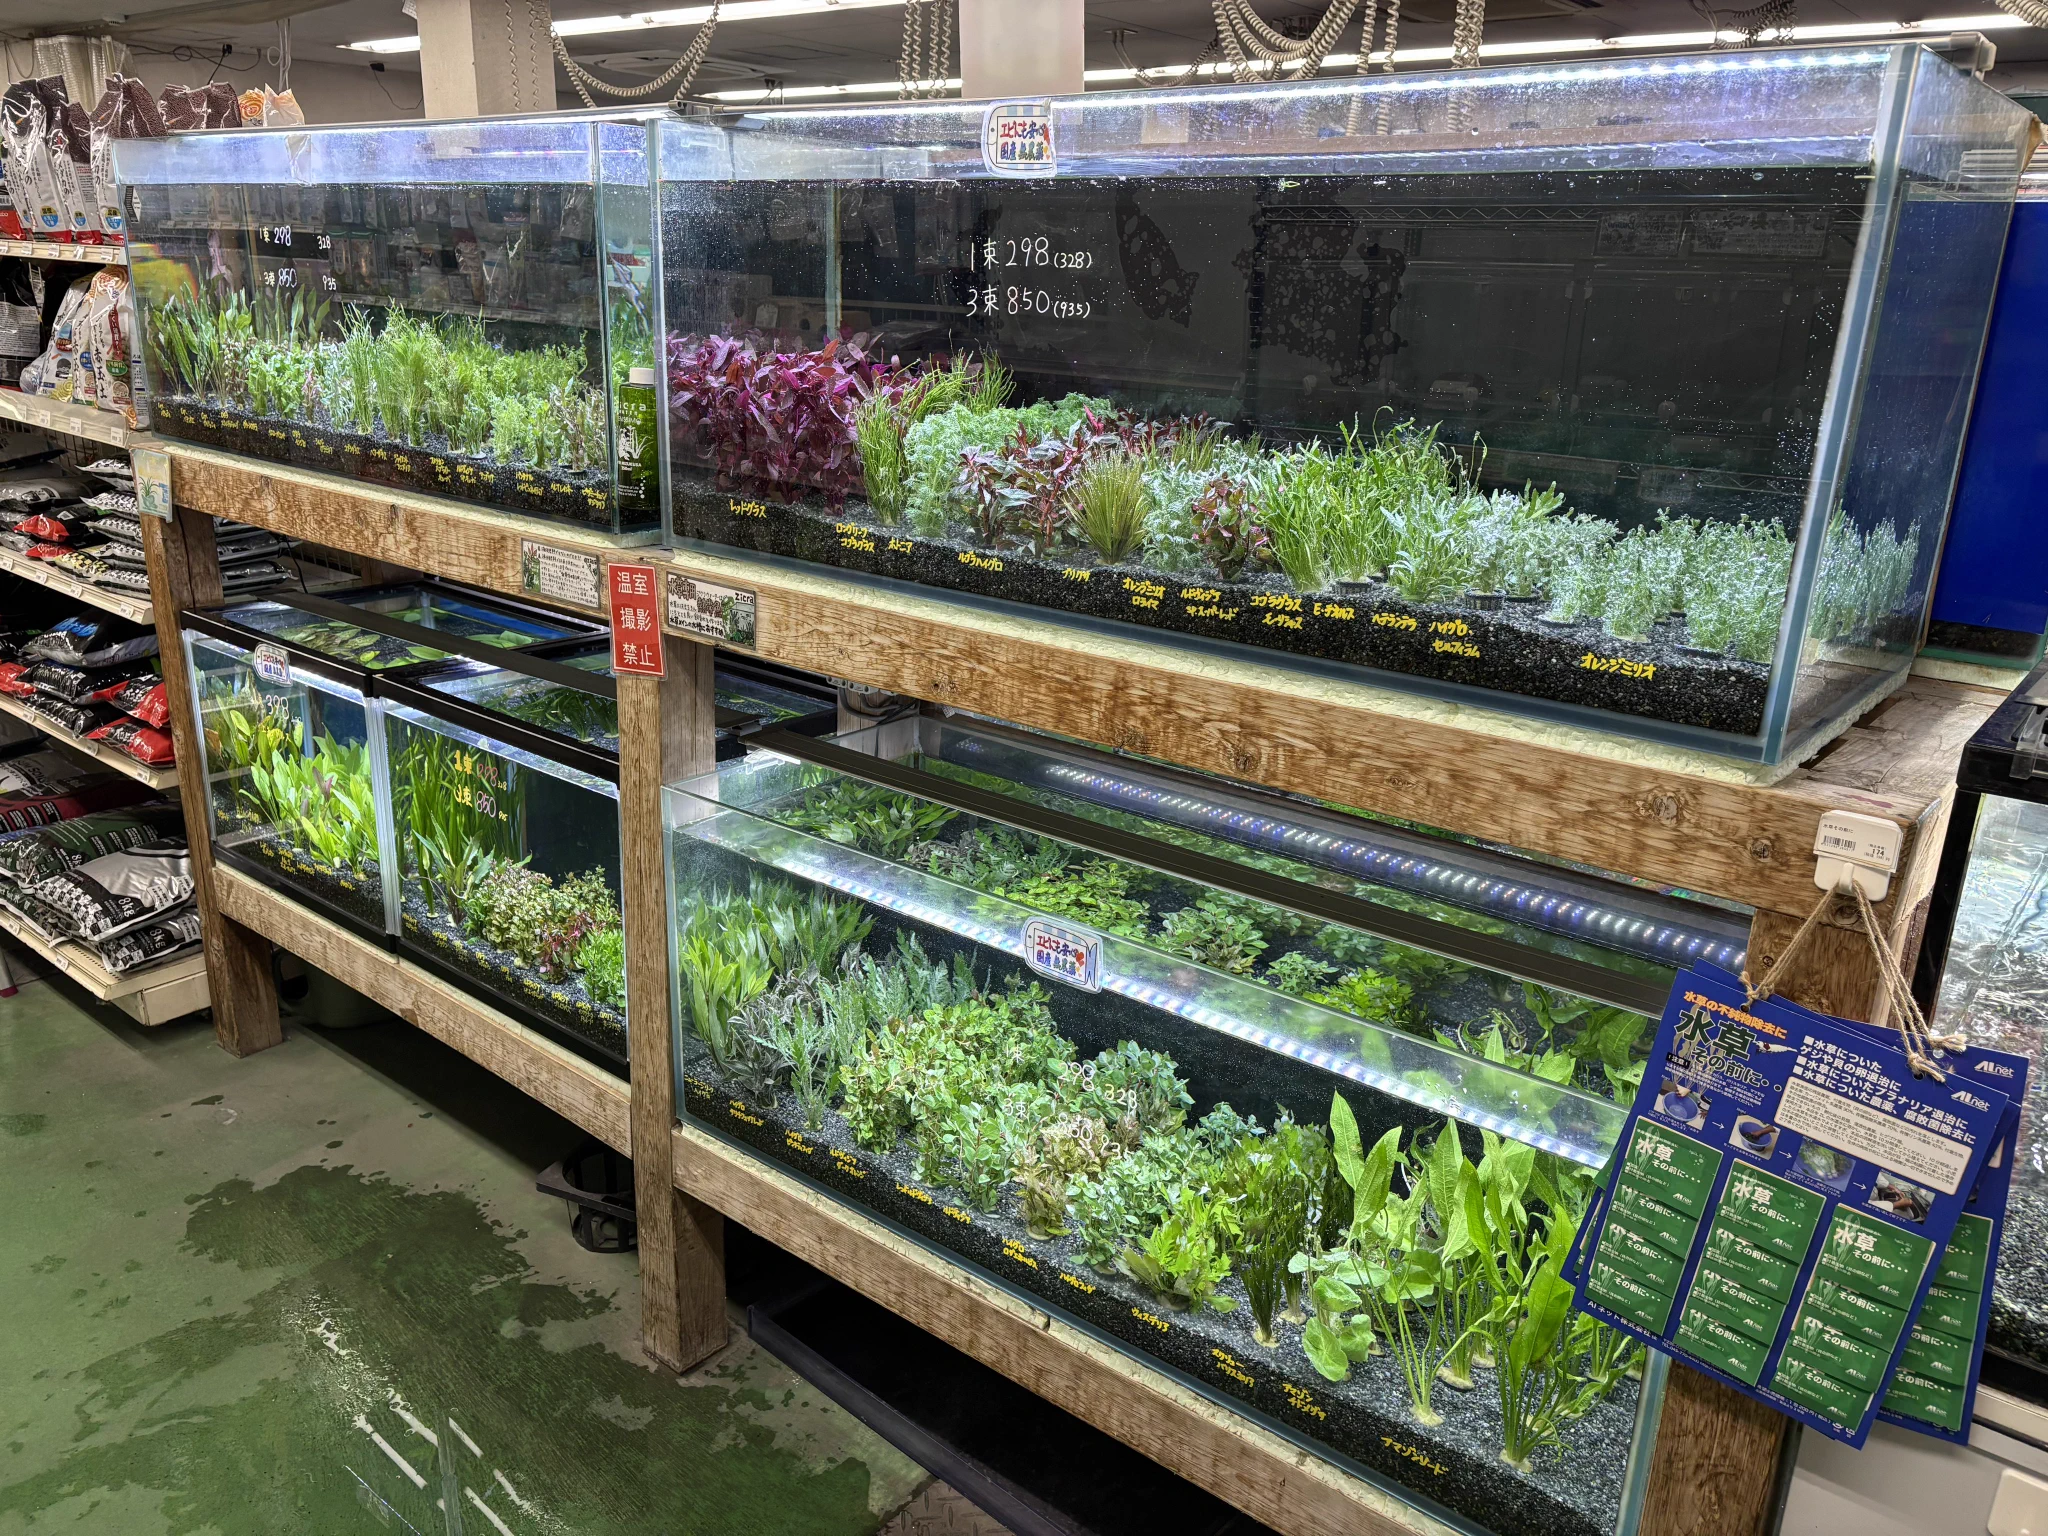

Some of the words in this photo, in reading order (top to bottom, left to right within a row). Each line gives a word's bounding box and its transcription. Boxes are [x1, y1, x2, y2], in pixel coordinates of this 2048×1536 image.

[274, 226, 292, 246] 298
[317, 235, 332, 250] 328
[970, 238, 999, 271] 1束
[1005, 237, 1049, 266] 298
[1054, 252, 1092, 269] (328)
[278, 268, 298, 288] 850
[322, 275, 336, 290] 935
[966, 284, 999, 317] 3束
[1007, 286, 1050, 315] 850
[1054, 302, 1090, 318] (935)
[616, 570, 649, 596] 温室
[619, 606, 652, 632] 撮影
[622, 642, 655, 666] 禁止
[1580, 652, 1656, 680] オレンジミリオ
[266, 694, 290, 720] 398
[476, 790, 496, 818] 850
[118, 897, 135, 918] 8kg
[150, 928, 166, 949] 8kg
[1674, 1008, 1758, 1061] 水草
[1058, 1062, 1095, 1092] 298
[1636, 1138, 1674, 1162] 水草
[1732, 1180, 1774, 1206] 水草
[1834, 1225, 1878, 1252] 水草
[1282, 1383, 1314, 1402] アマゾン
[1380, 1436, 1450, 1476] アマゾンソード
